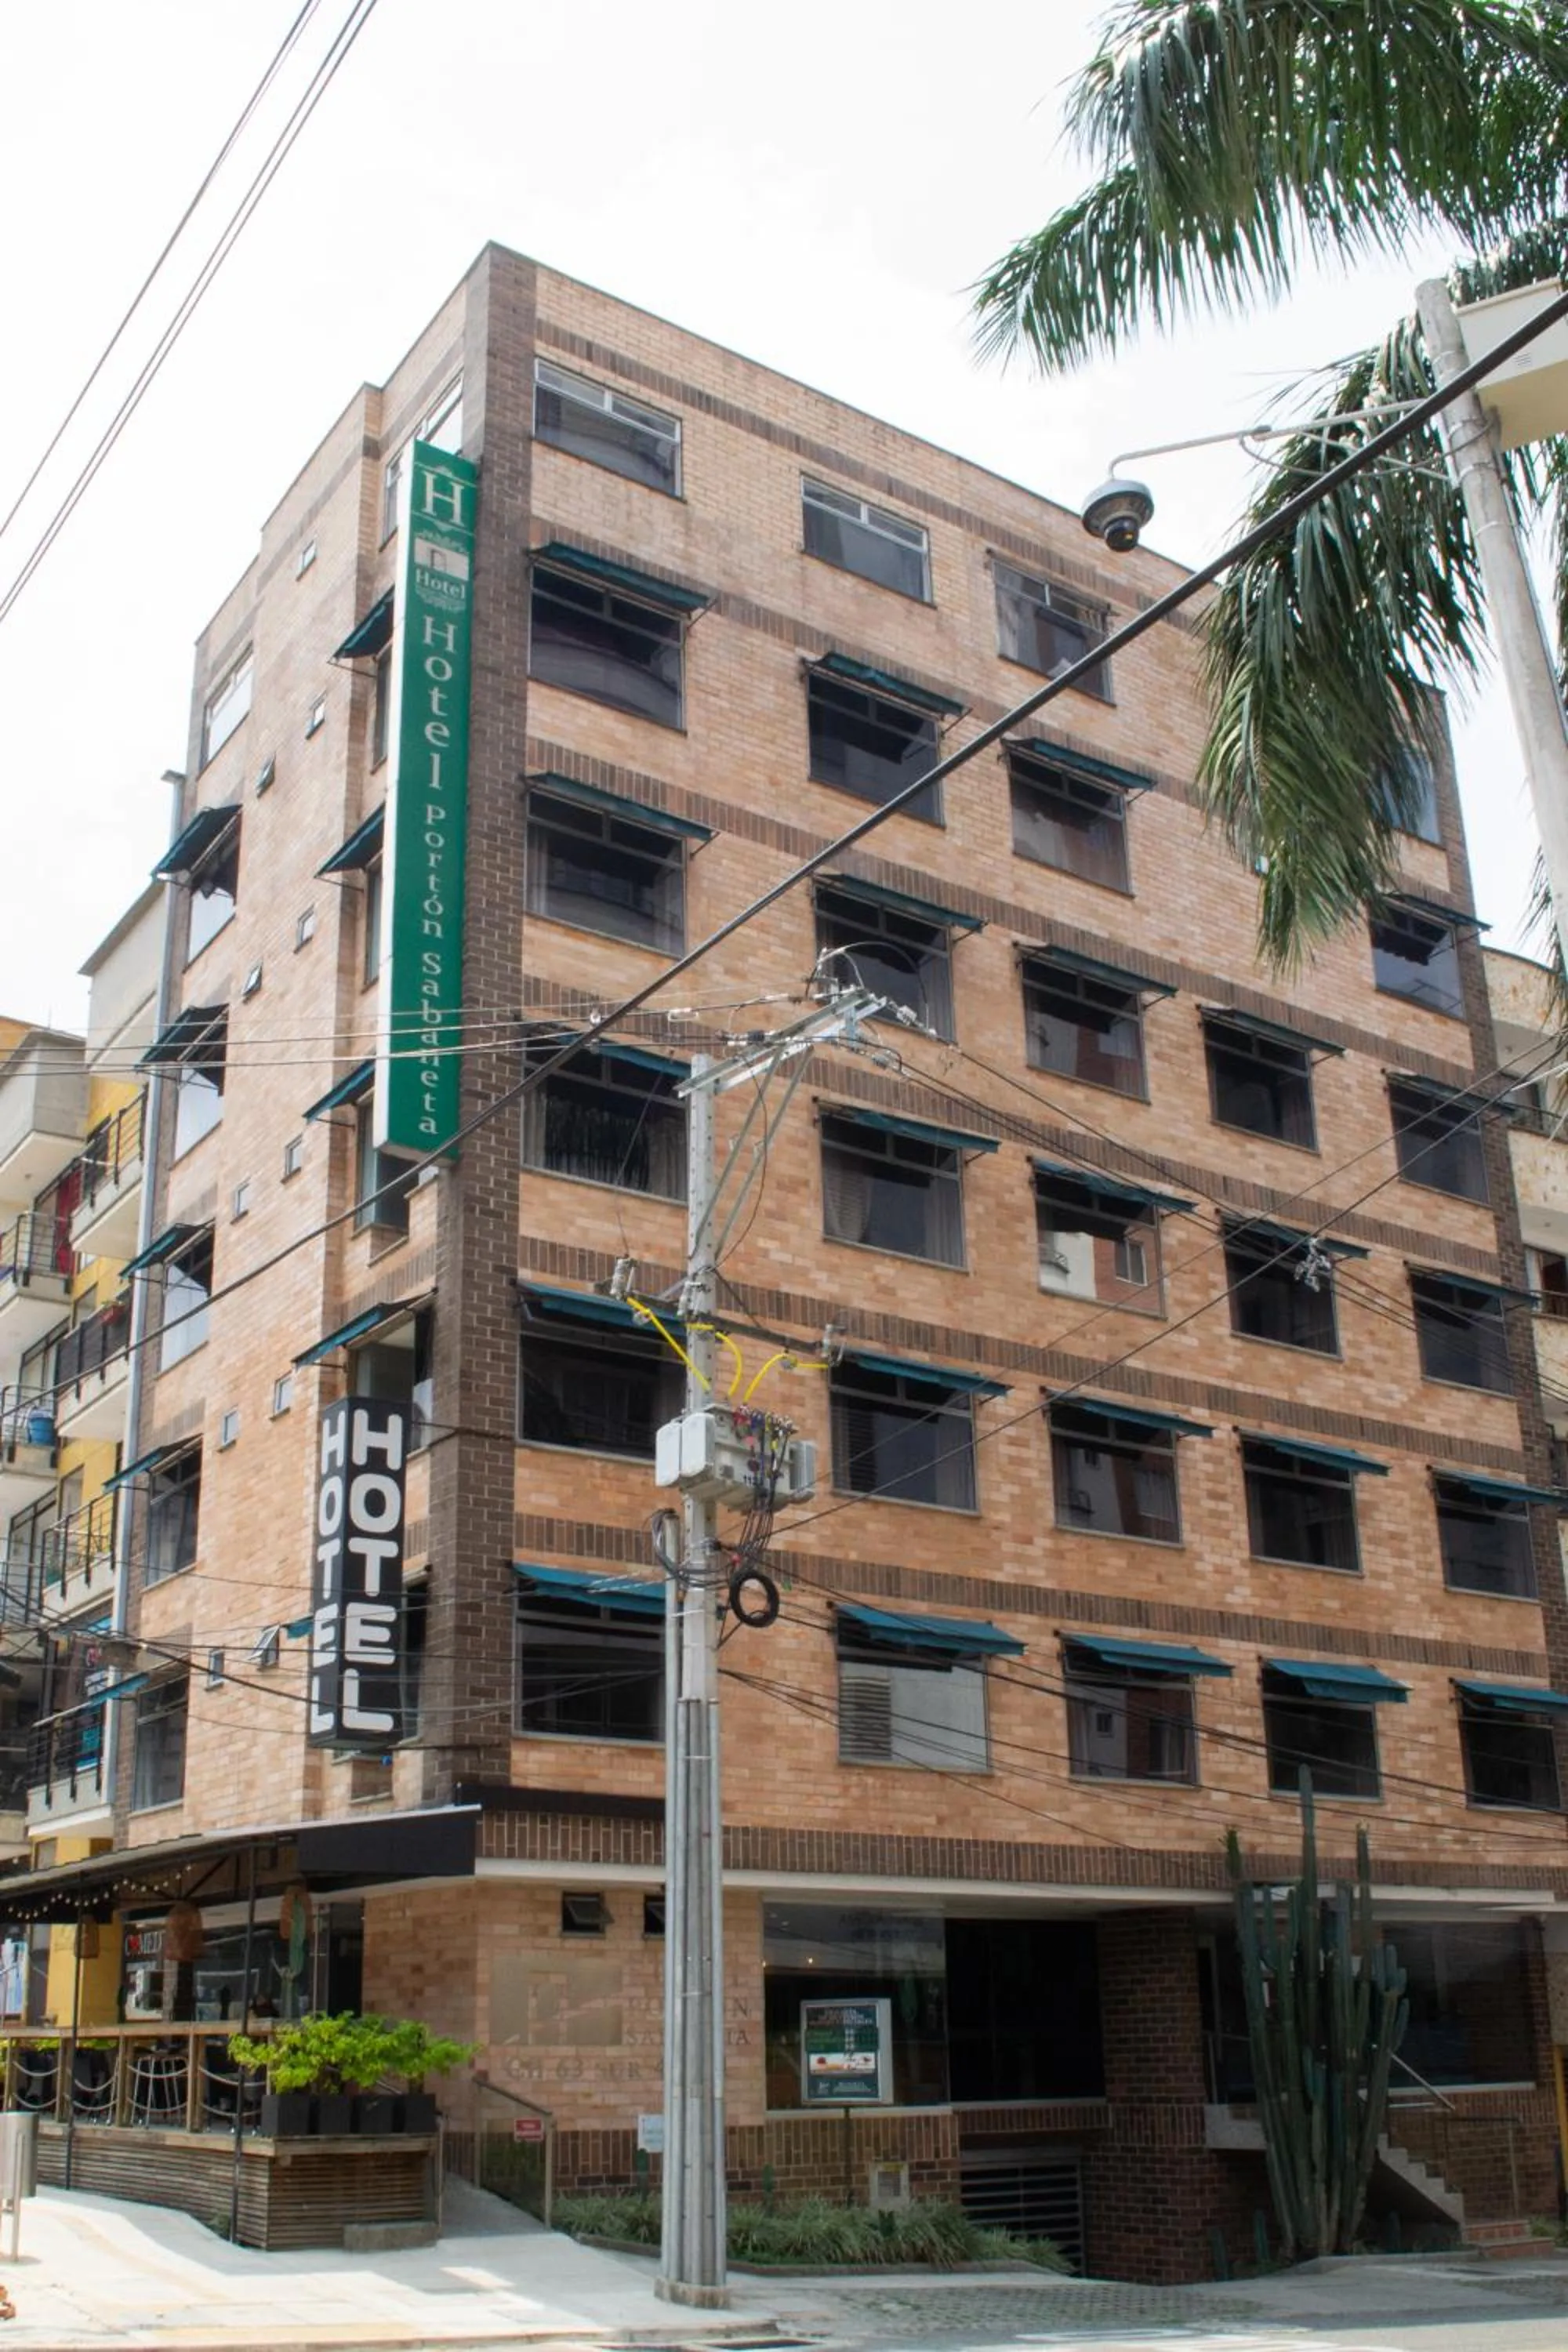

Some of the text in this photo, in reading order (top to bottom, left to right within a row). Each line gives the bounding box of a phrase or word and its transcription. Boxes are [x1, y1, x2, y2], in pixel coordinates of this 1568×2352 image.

[416, 568, 466, 599] Hotel
[421, 470, 465, 528] H
[423, 615, 458, 791] Hotel
[418, 953, 441, 1135] Sabaneta
[310, 1410, 346, 1735] HOTEL
[342, 1408, 403, 1732] HOTEL
